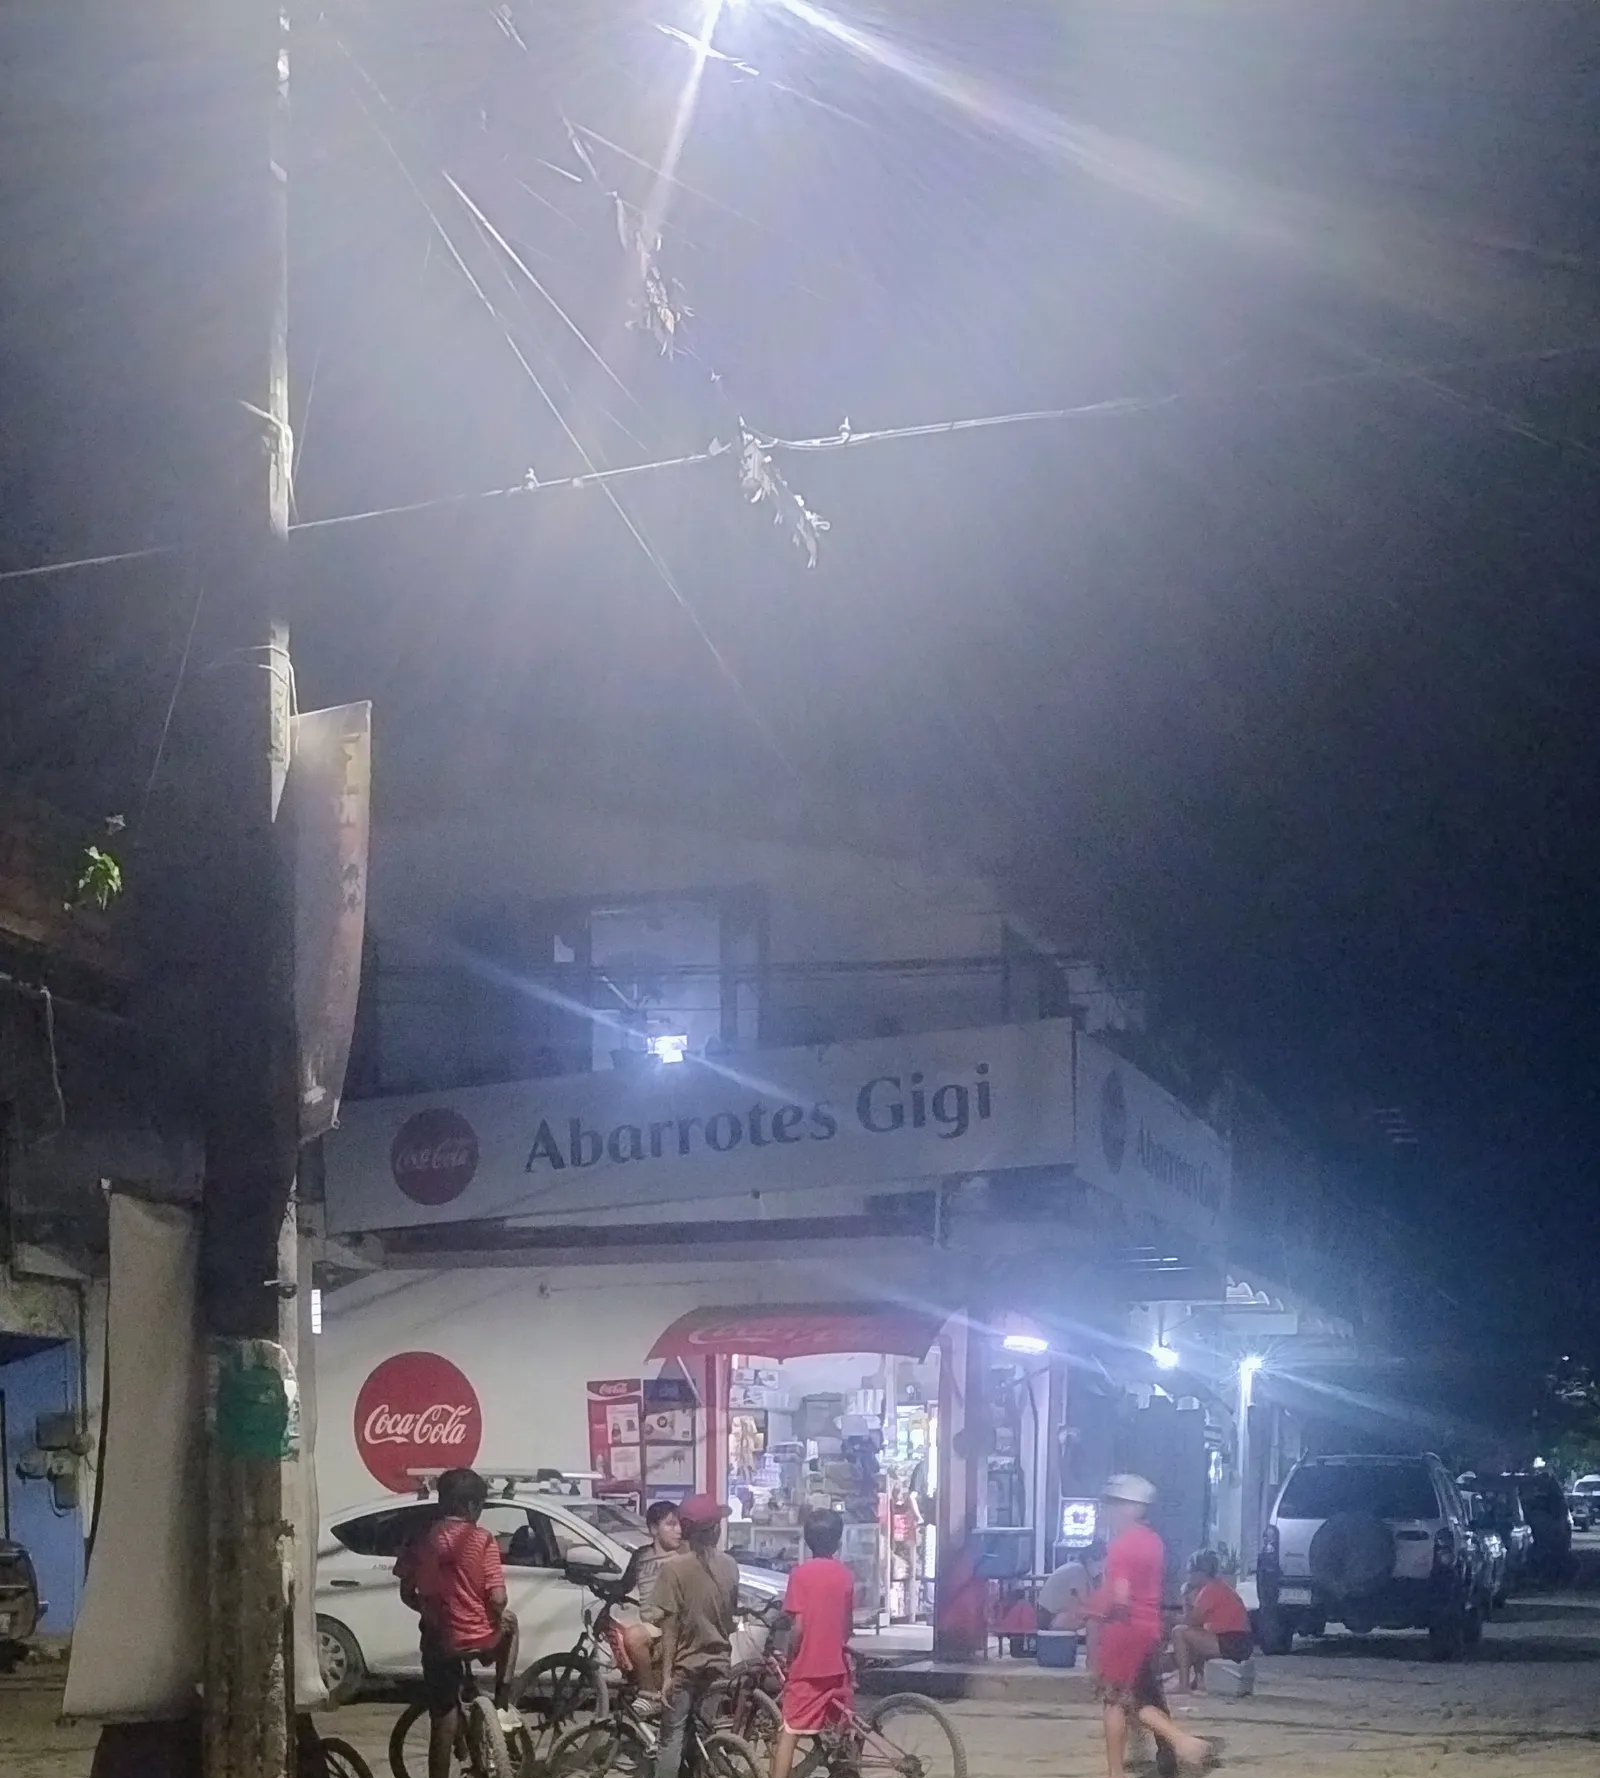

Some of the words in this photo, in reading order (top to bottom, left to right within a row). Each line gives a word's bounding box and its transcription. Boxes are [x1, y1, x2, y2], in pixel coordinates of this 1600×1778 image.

[525, 1099, 838, 1173] Abarrotes
[856, 1063, 992, 1140] Gigi
[364, 1404, 473, 1445] Coca-Cola
